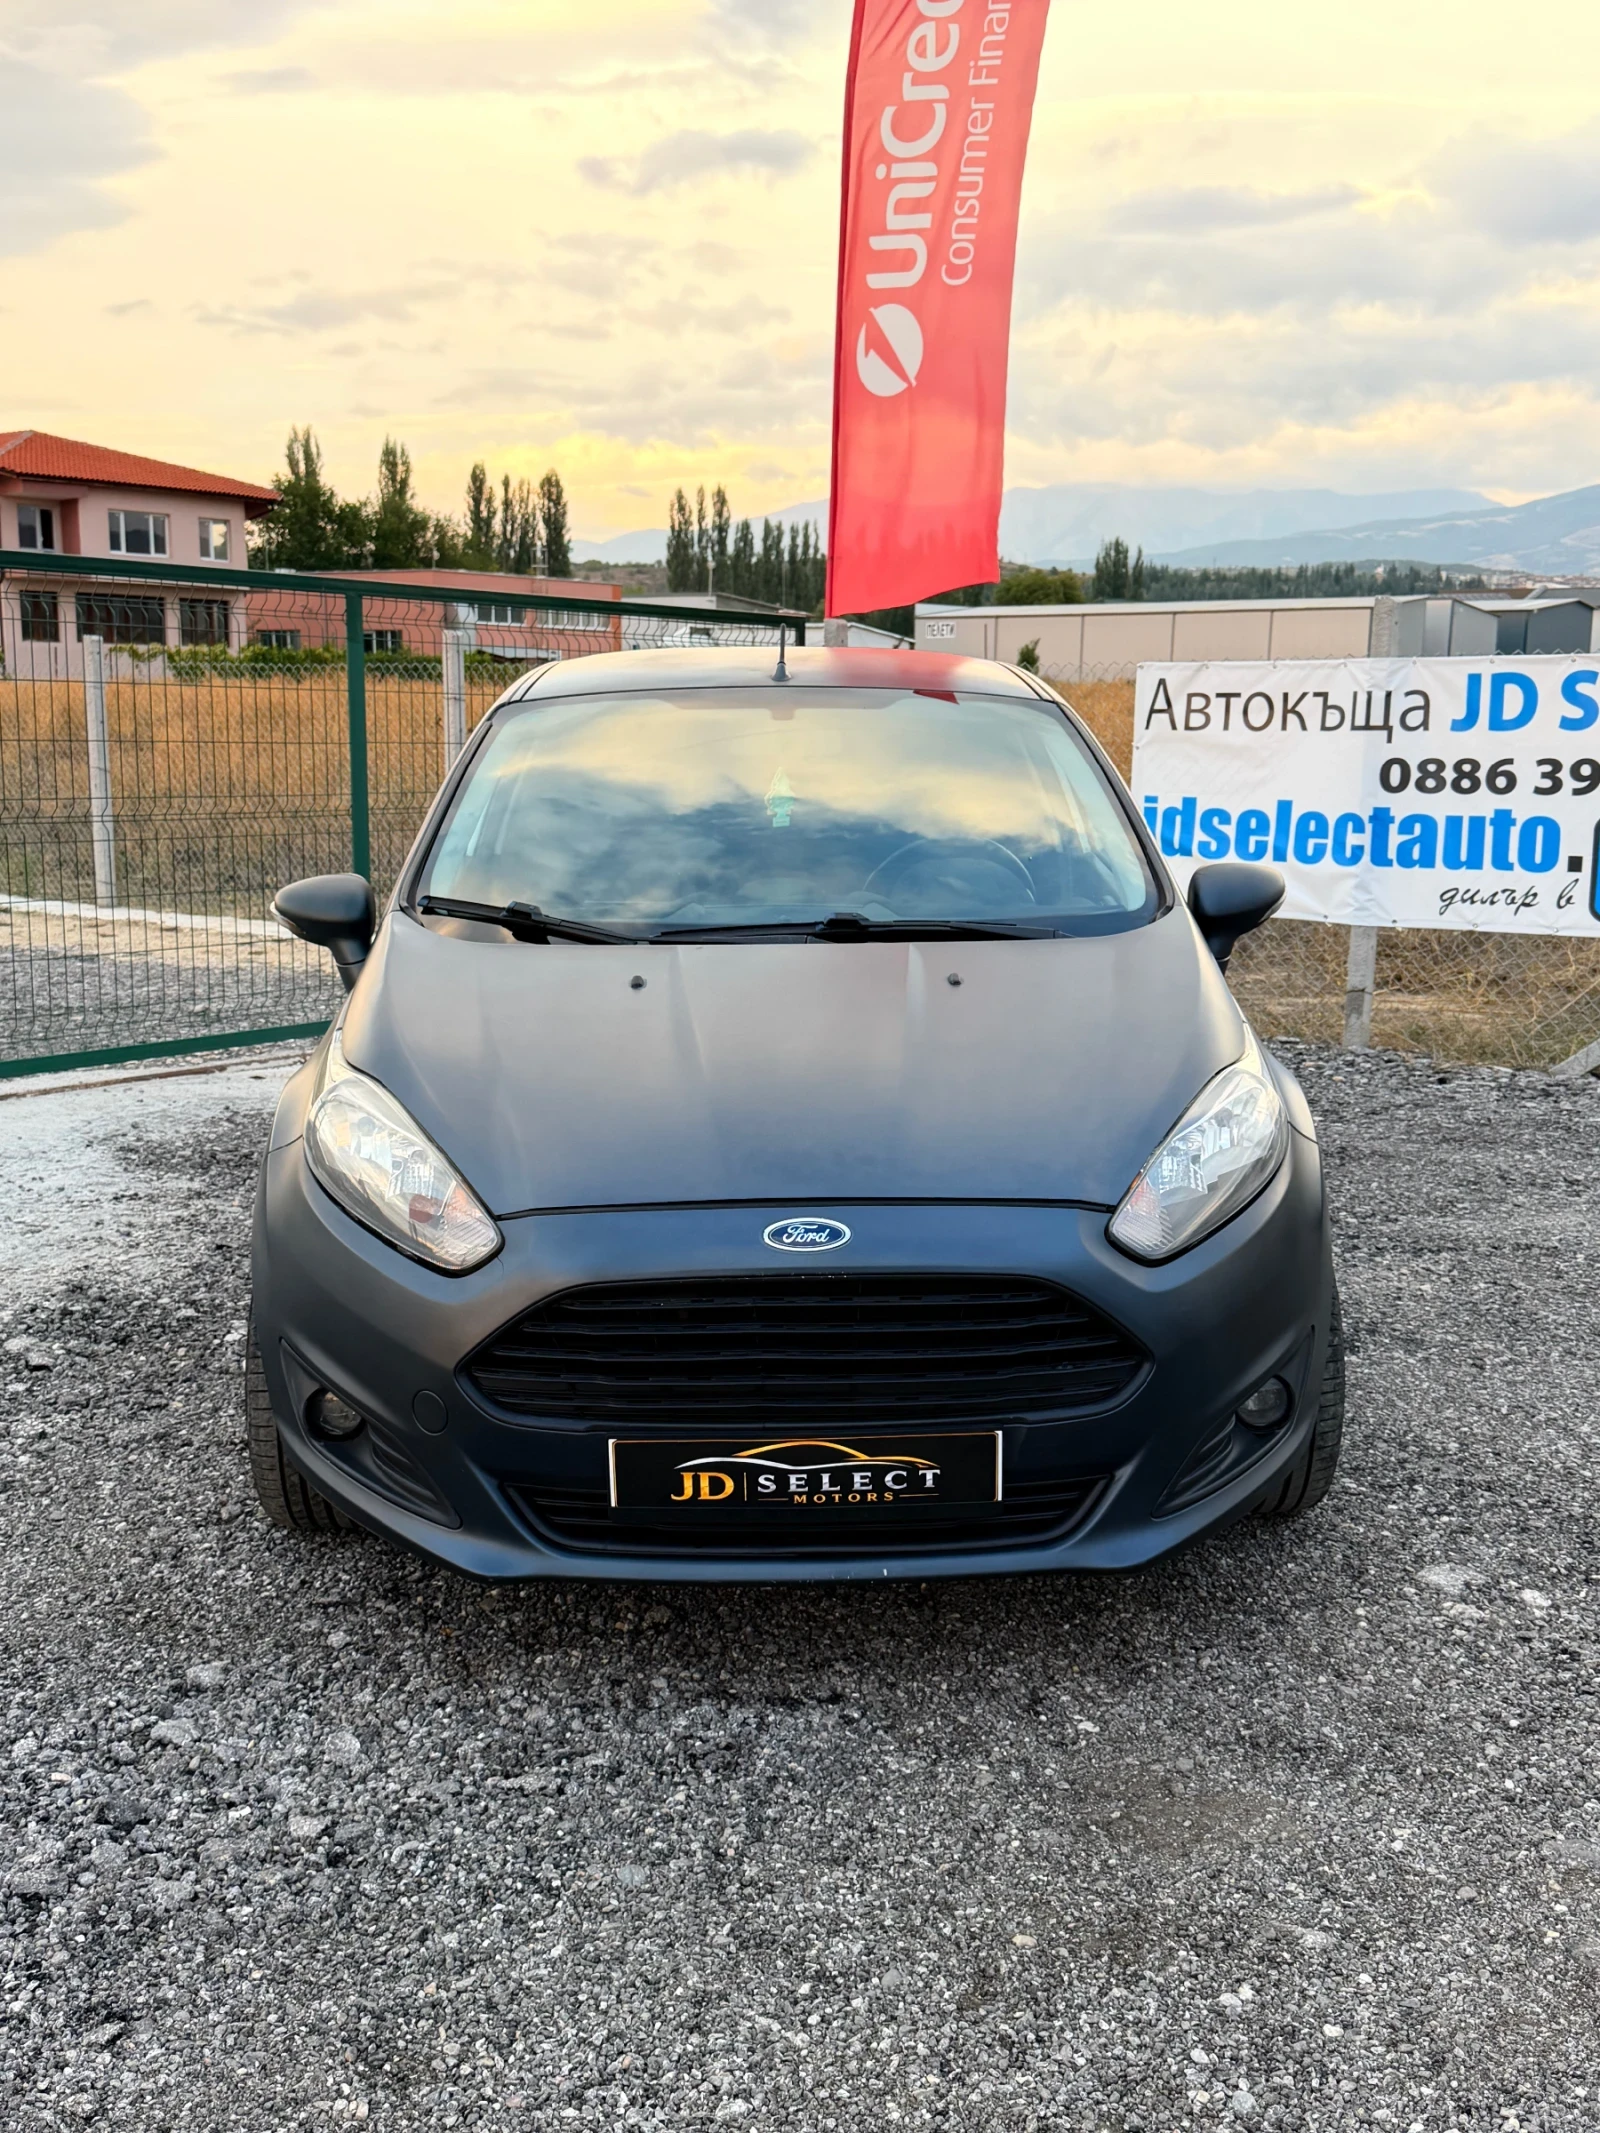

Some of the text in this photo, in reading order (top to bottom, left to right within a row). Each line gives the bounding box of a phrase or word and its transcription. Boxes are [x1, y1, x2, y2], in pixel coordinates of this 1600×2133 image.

[941, 97, 995, 286] Consumer
[1144, 669, 1600, 744] Автокъща JD S
[1379, 757, 1600, 796] 0886 39
[1438, 884, 1540, 916] дилър
[782, 1223, 830, 1243] Ford
[670, 1468, 941, 1501] JD SELECT
[793, 1491, 895, 1504] MOTORS
